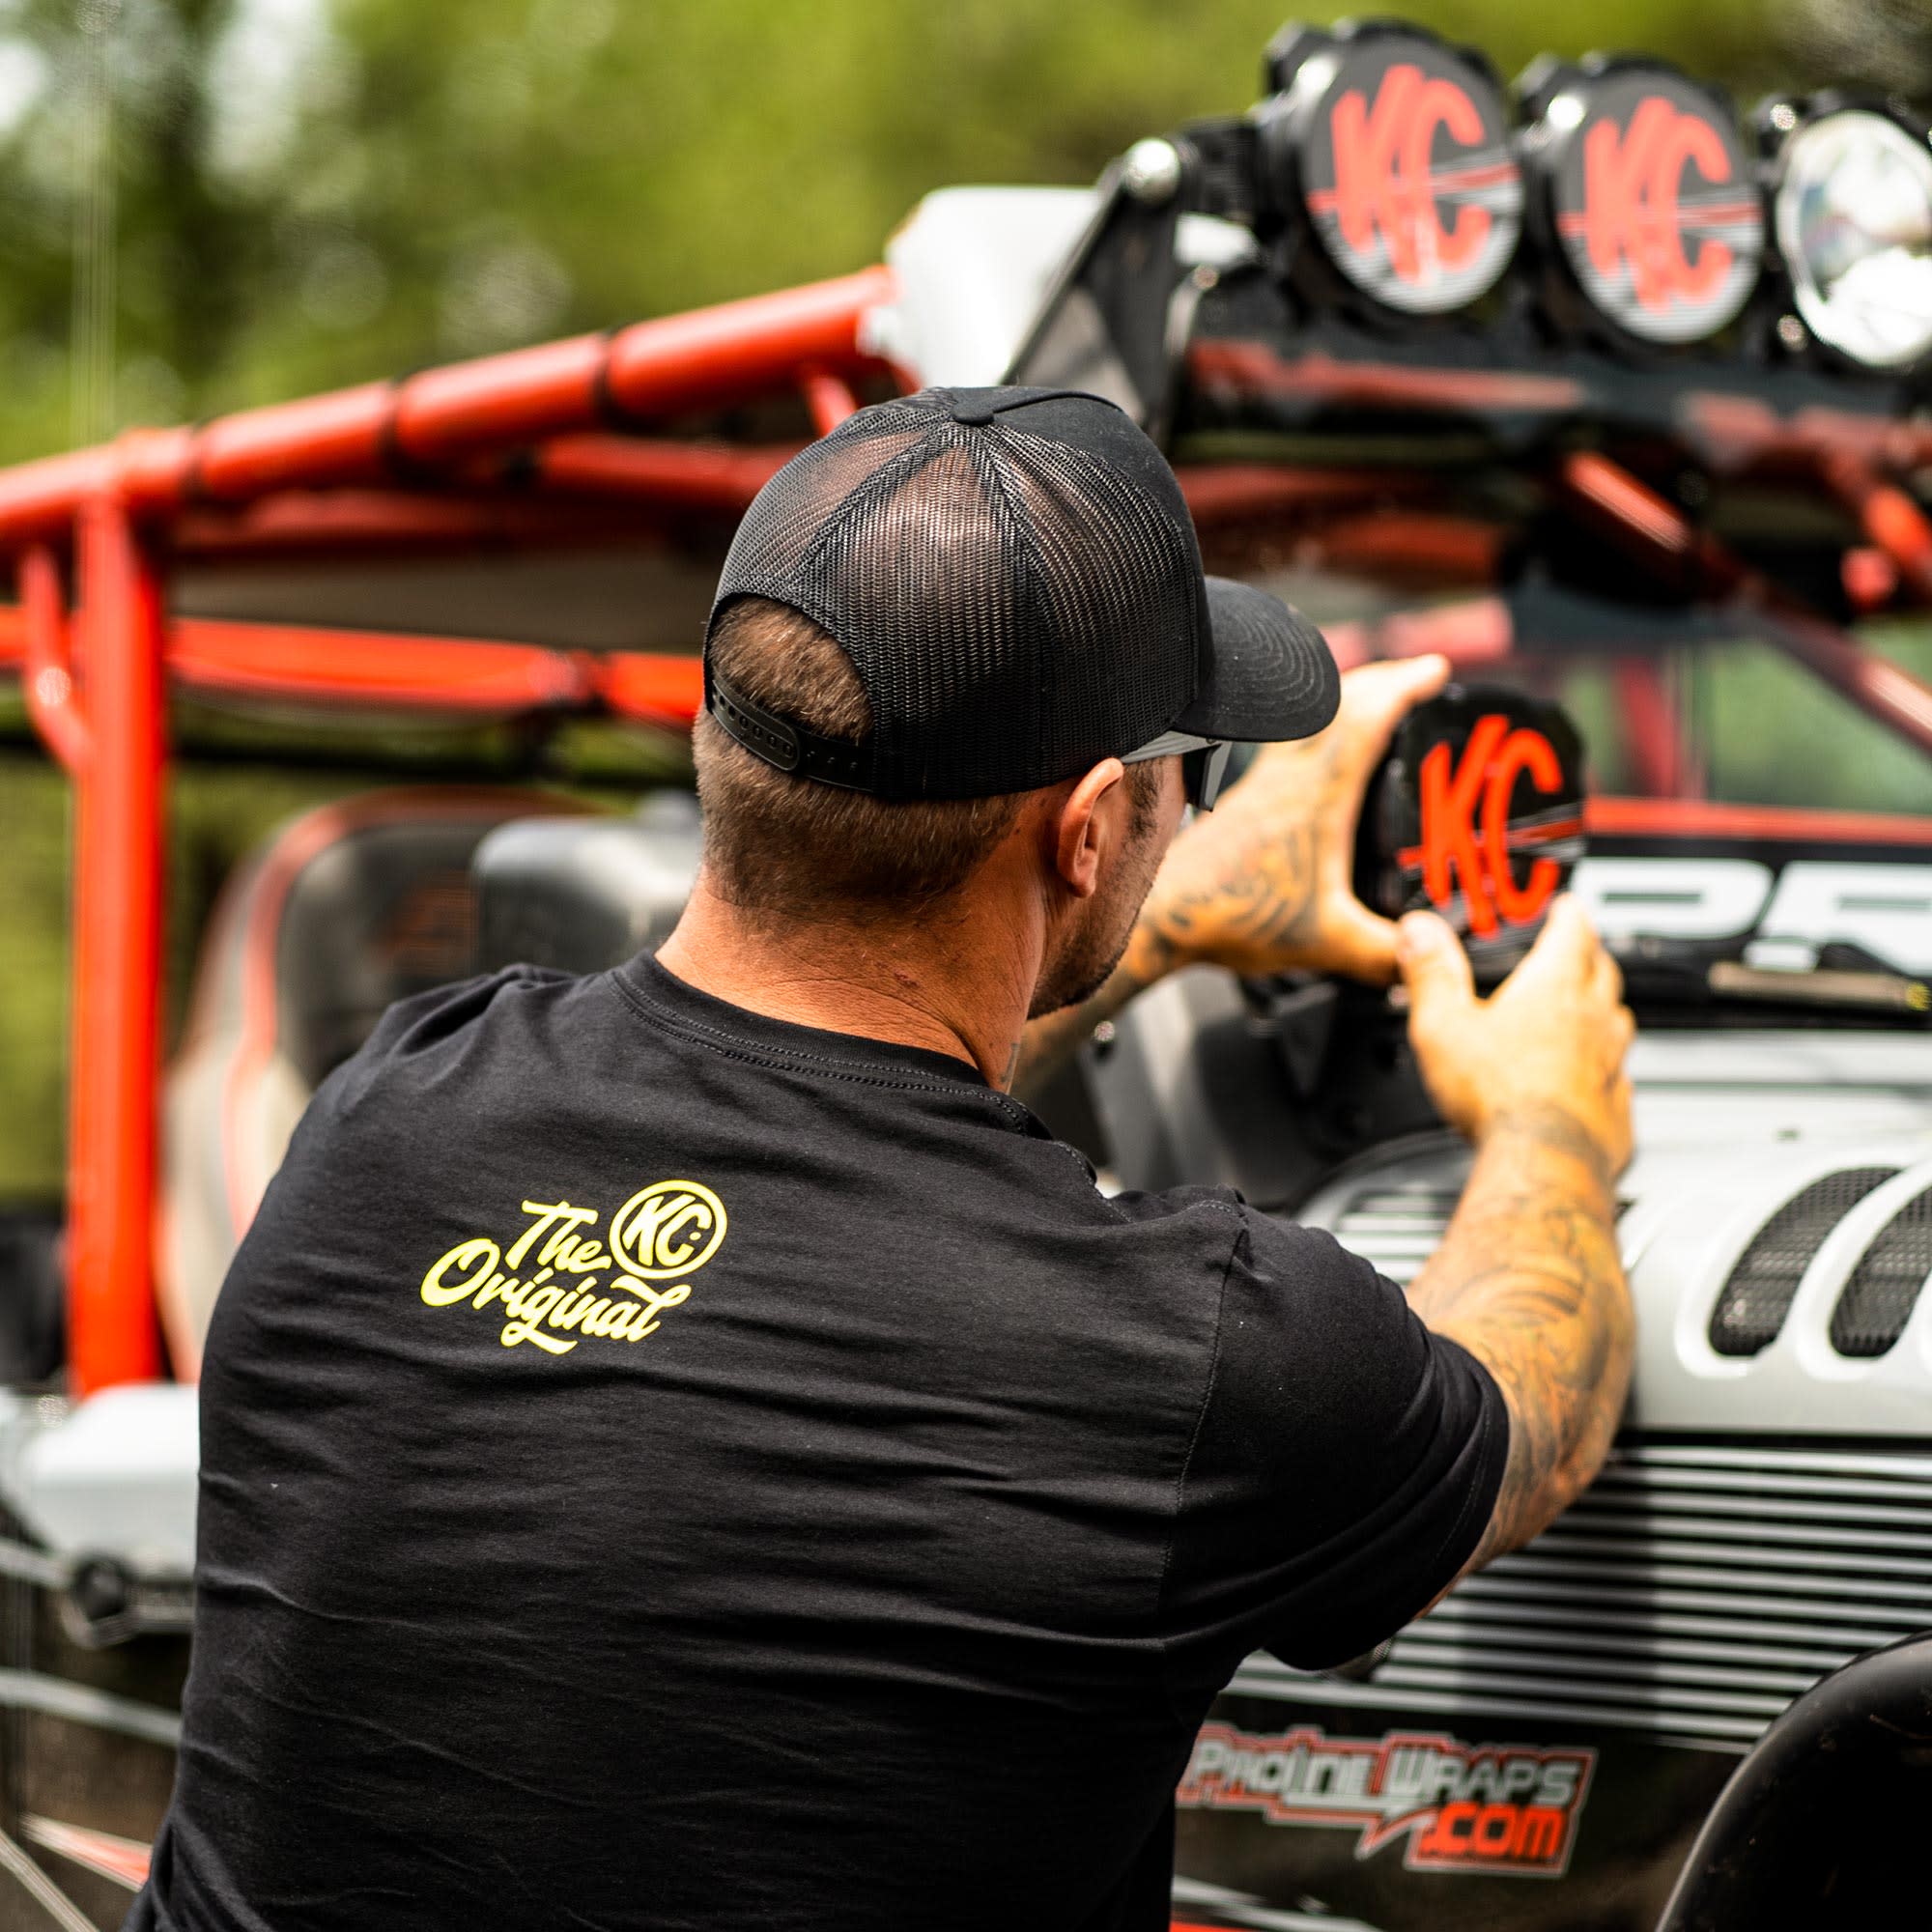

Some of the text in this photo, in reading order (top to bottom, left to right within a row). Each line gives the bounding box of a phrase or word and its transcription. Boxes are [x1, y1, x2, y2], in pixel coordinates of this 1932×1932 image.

[1327, 64, 1493, 287] KC
[1580, 97, 1733, 315] KC
[1416, 714, 1563, 939] KC
[420, 1237, 692, 1354] Original
[505, 1200, 611, 1273] The
